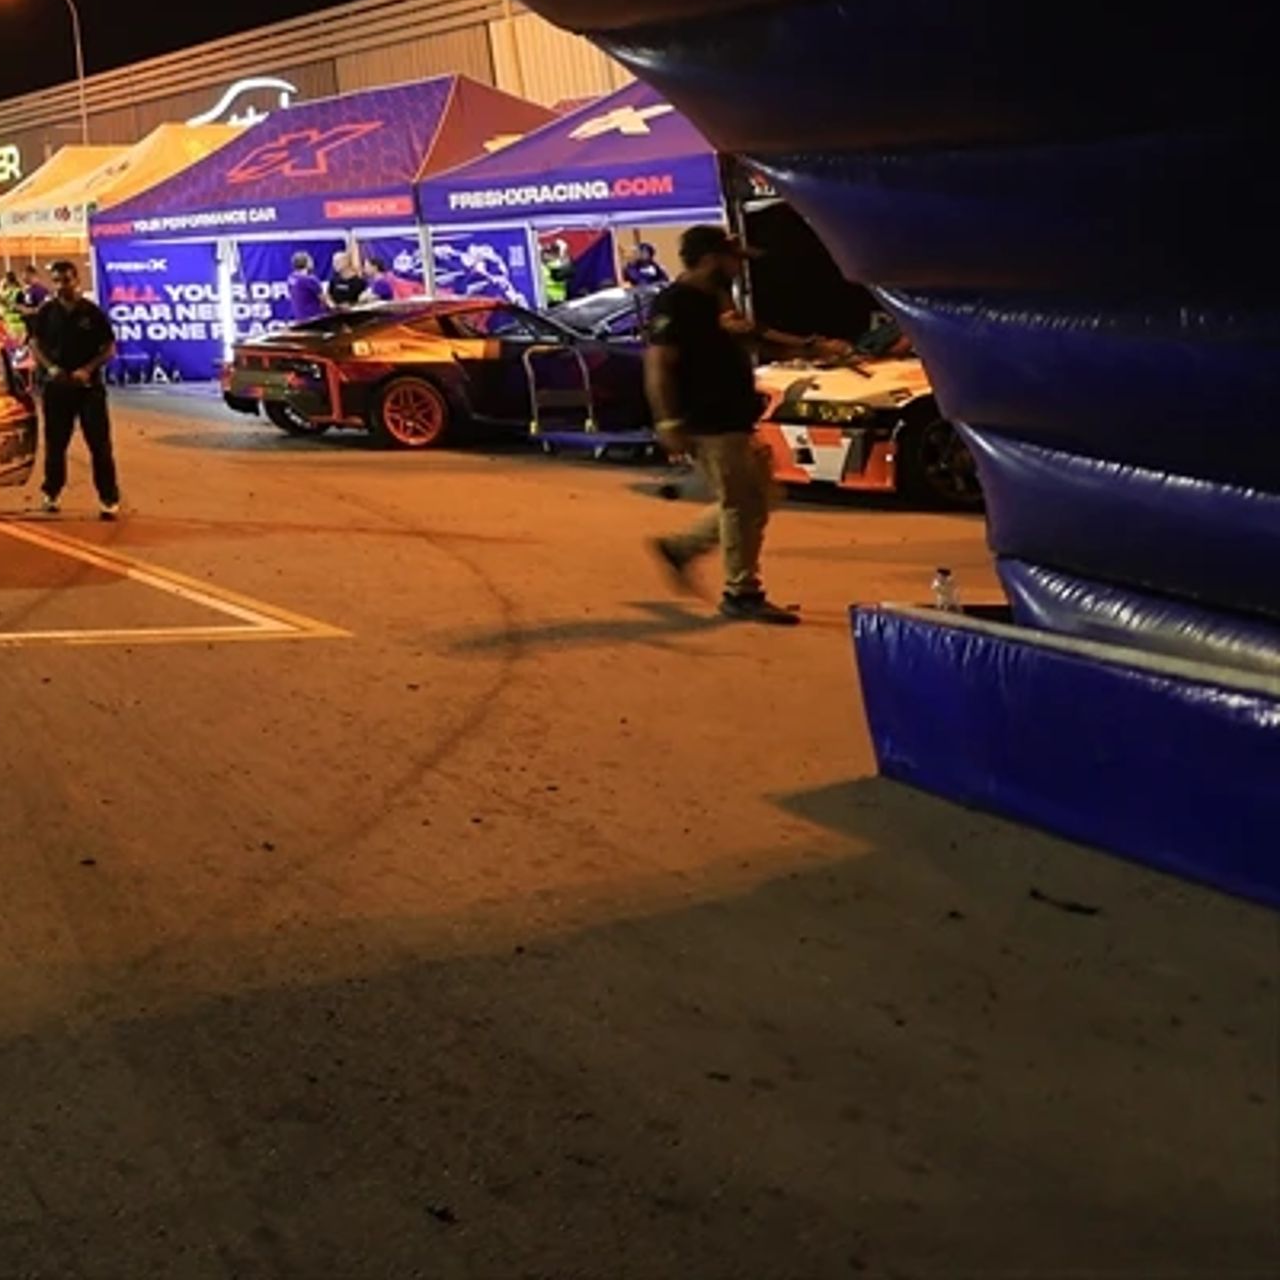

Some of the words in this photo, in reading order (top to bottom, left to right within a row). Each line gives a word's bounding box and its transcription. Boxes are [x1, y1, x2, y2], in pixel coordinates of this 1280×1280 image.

[448, 175, 674, 210] FRESHXRACING.COM
[163, 210, 247, 231] PERFORMANCE
[249, 207, 277, 222] CAR
[109, 303, 172, 322] CAR
[147, 323, 207, 341] ONE
[210, 320, 290, 341] PLAC
